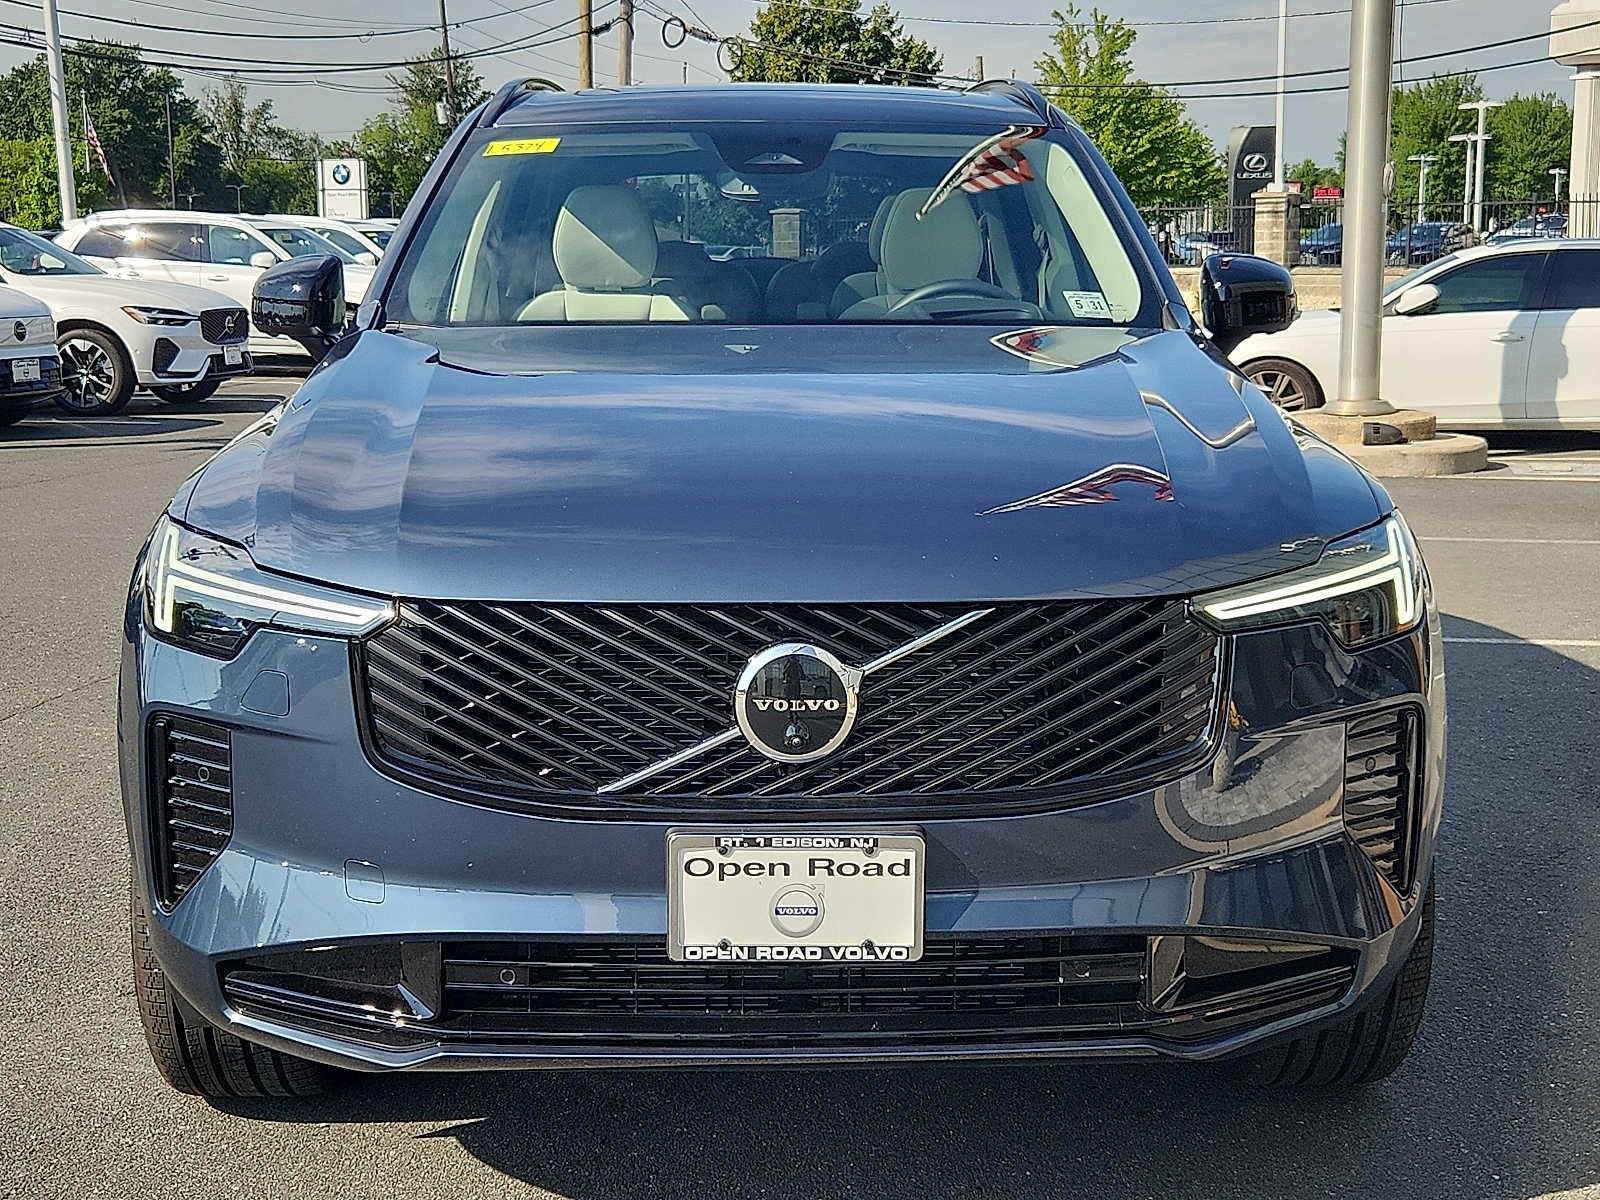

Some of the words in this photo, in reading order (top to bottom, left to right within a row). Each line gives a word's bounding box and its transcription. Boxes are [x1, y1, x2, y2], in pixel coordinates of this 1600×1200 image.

[1075, 299, 1084, 309] 5
[1090, 301, 1105, 310] 31
[752, 699, 840, 711] VOLVO
[720, 838, 748, 848] RT.
[757, 838, 764, 847] 1
[772, 838, 844, 849] EDISON,
[851, 838, 875, 849] NJ
[684, 858, 790, 881] Open
[808, 858, 910, 877] Road
[776, 907, 817, 915] VOLVO
[685, 947, 748, 960] OPEN
[756, 947, 821, 960] ROAD
[829, 947, 909, 960] VOLVO
